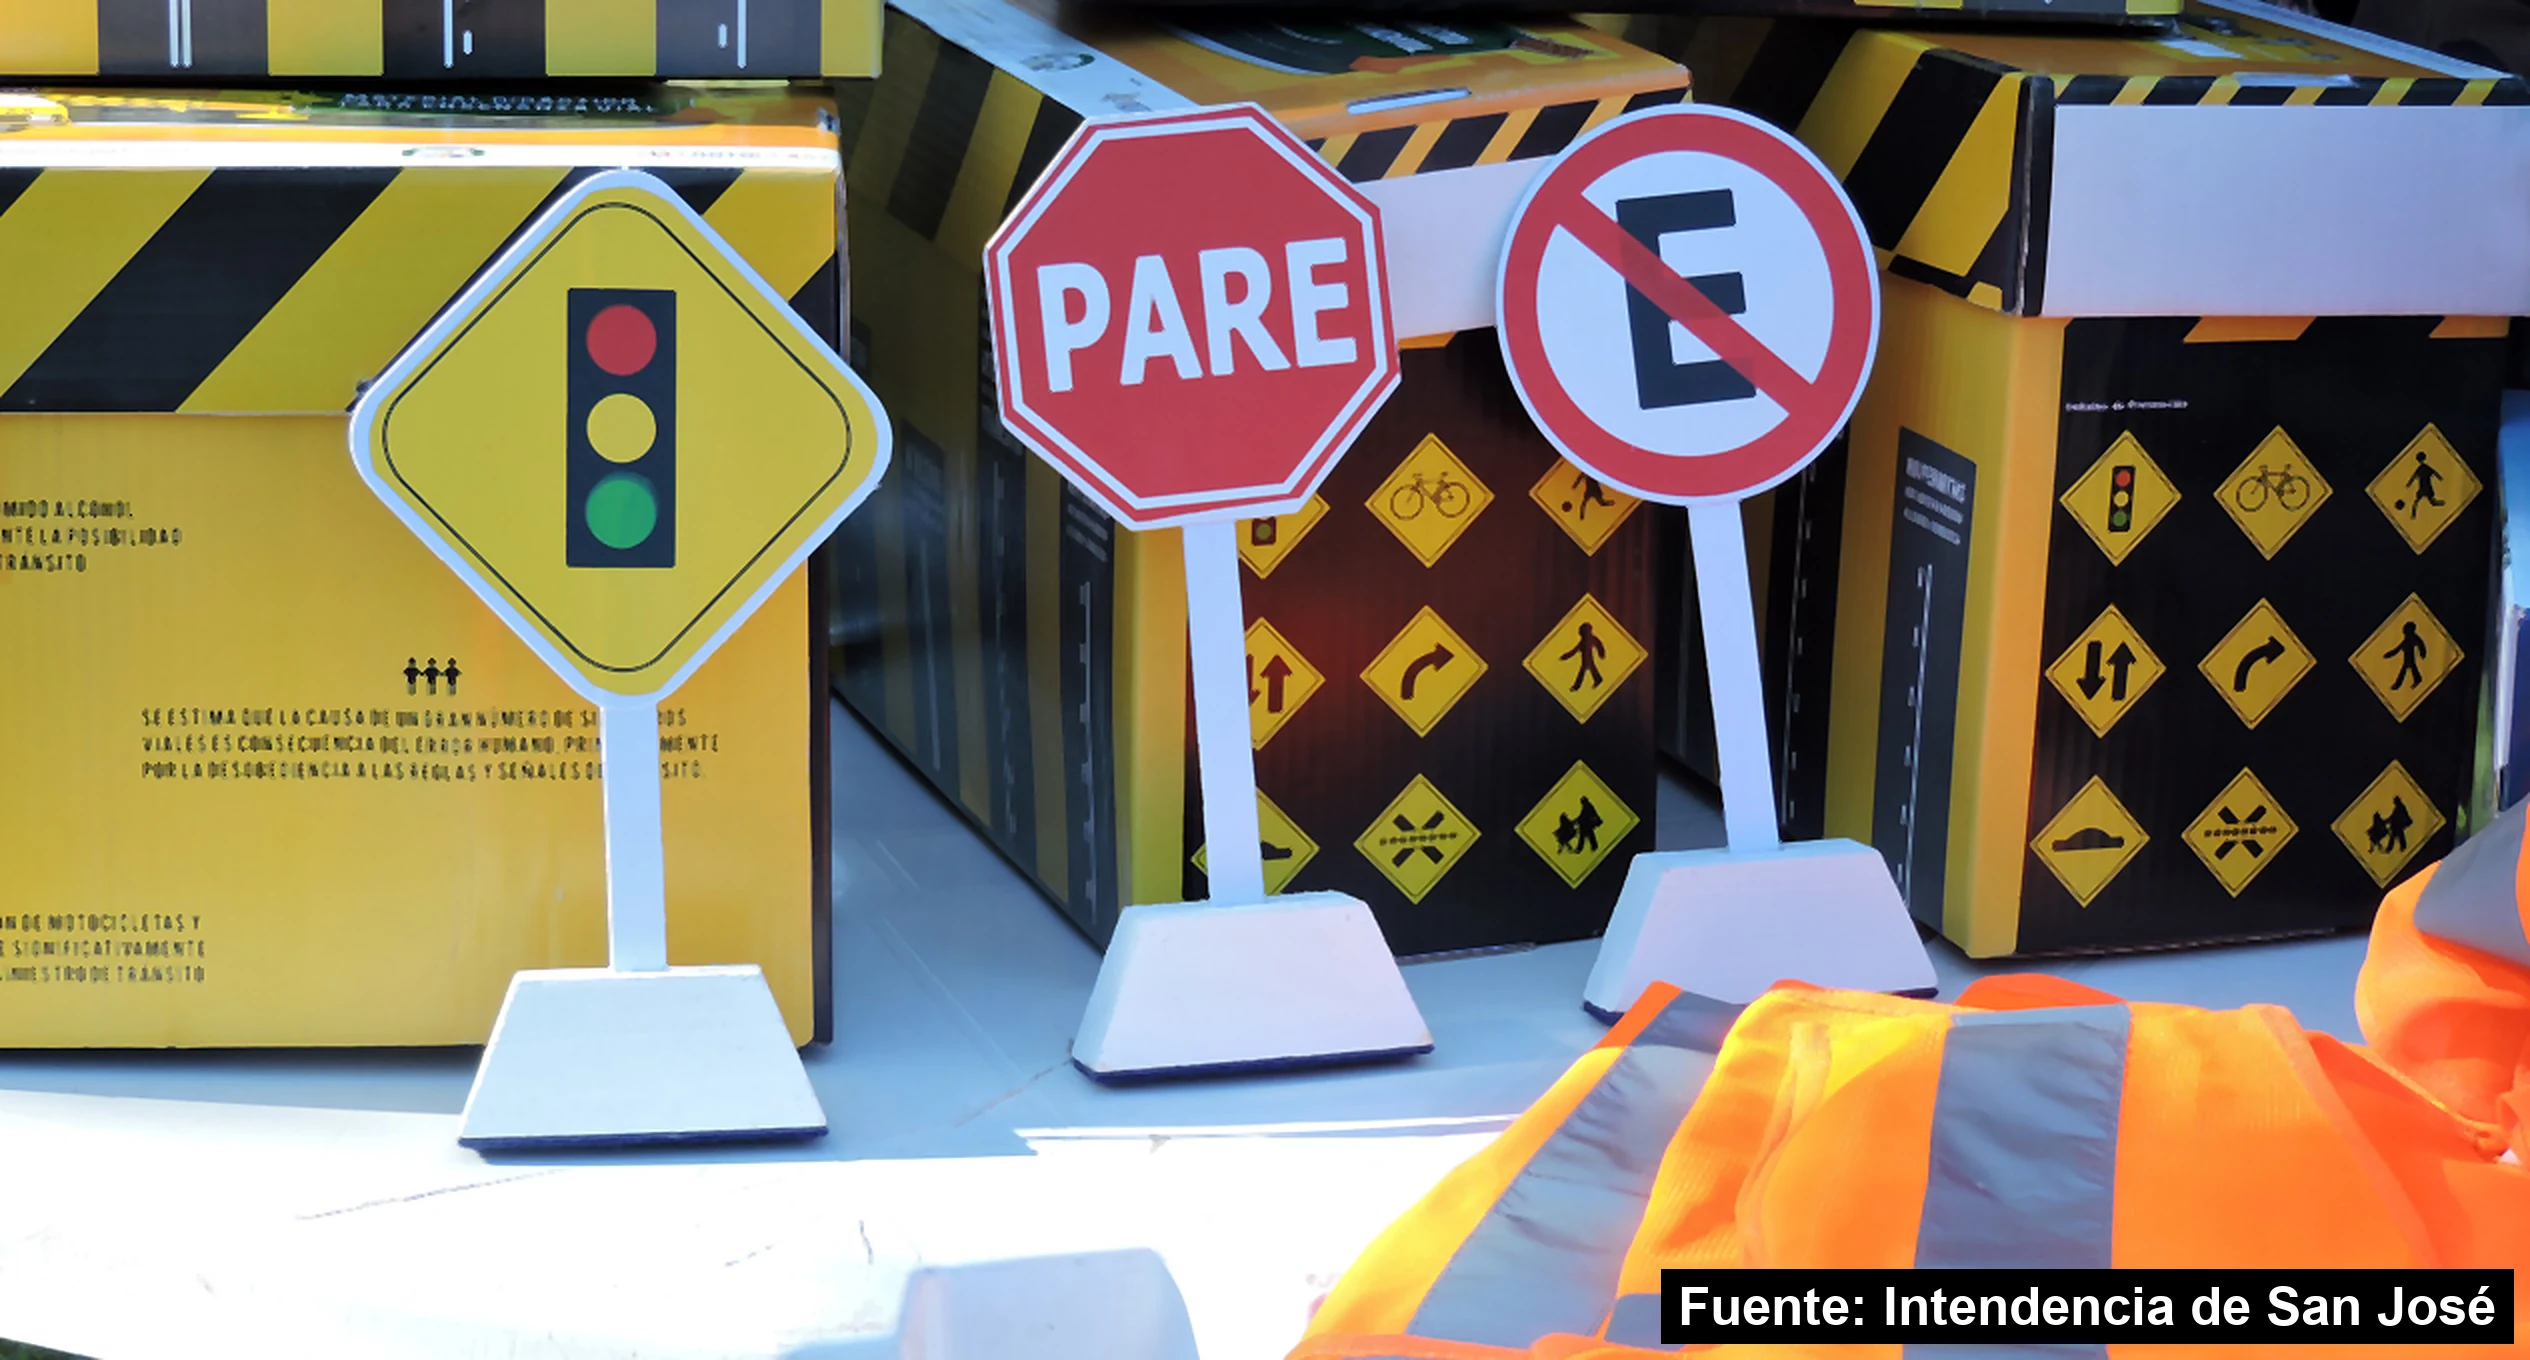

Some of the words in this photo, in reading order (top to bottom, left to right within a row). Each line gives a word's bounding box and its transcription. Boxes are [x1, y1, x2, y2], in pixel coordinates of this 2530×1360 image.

[1616, 188, 1757, 411] E
[1036, 237, 1358, 393] PARE
[67, 527, 183, 547] POSIBILIDAD
[166, 708, 236, 727] ESTIMA
[241, 708, 273, 727] QUE
[279, 709, 301, 727] LA
[305, 708, 365, 727] CAUSA
[369, 708, 389, 728] DE
[553, 709, 573, 728] DE
[142, 735, 206, 753] VIALES
[211, 734, 232, 753] ES
[237, 734, 375, 753] CONSECUENCIA
[379, 735, 409, 754] DEL
[141, 762, 177, 780] POR
[182, 763, 203, 780] LA
[207, 762, 350, 780] DESOBEDIENCIA
[371, 761, 405, 781] LAS
[484, 763, 493, 780] Y
[22, 914, 41, 933] DE
[47, 914, 184, 933] MOTOCICLETAS
[191, 915, 201, 931] Y
[12, 940, 206, 958] SIGNIFICATIVAMENTE
